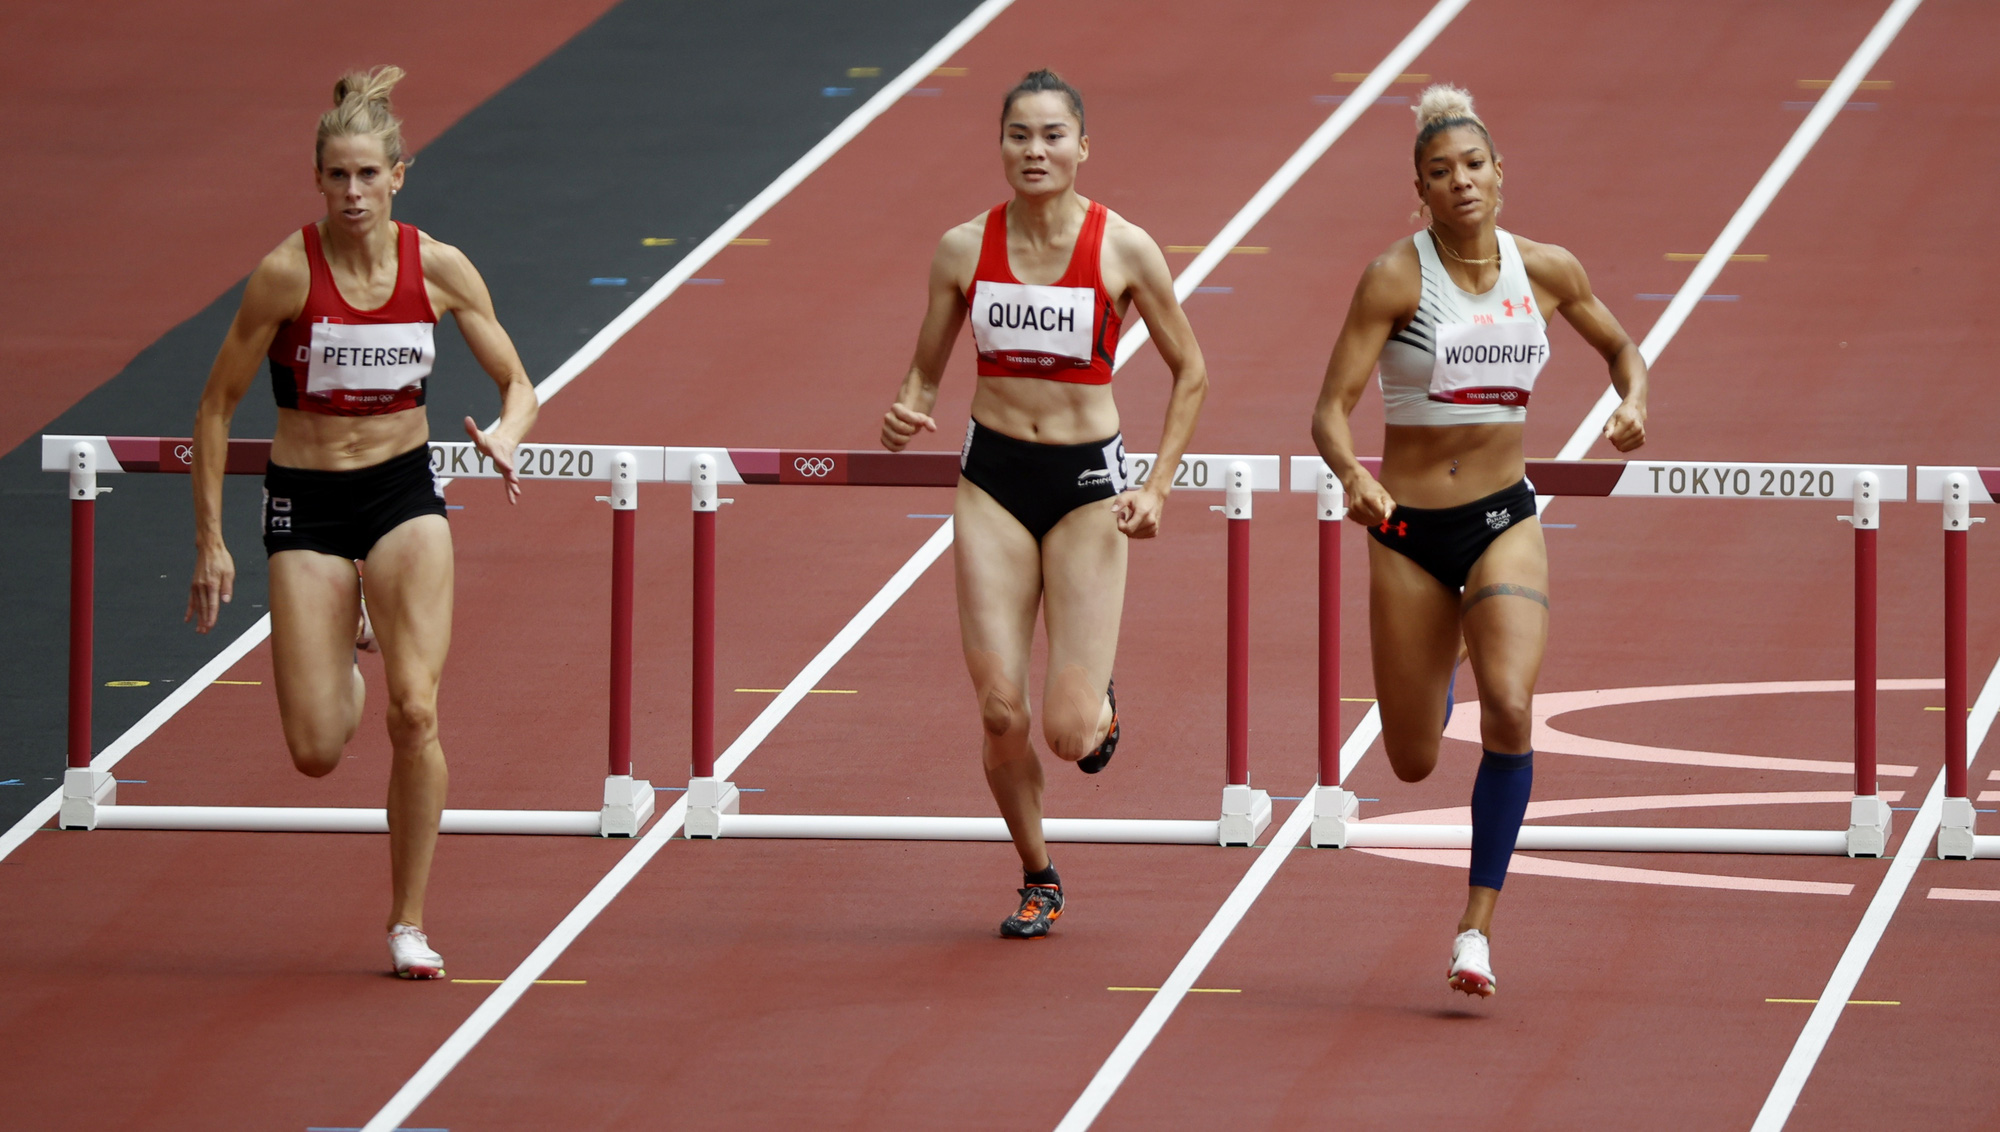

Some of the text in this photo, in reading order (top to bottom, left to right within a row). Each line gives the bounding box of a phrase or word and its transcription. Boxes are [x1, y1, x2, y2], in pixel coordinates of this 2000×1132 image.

[988, 302, 1074, 332] QUACH
[1473, 314, 1494, 325] PAN
[296, 345, 309, 362] D
[323, 346, 423, 366] PETERSEN
[1445, 343, 1546, 364] WOODRUFF
[428, 446, 594, 477] OKY 2020
[1134, 459, 1208, 487] 220
[1648, 466, 1834, 498] TOKYO 2020
[271, 497, 292, 533] DE
